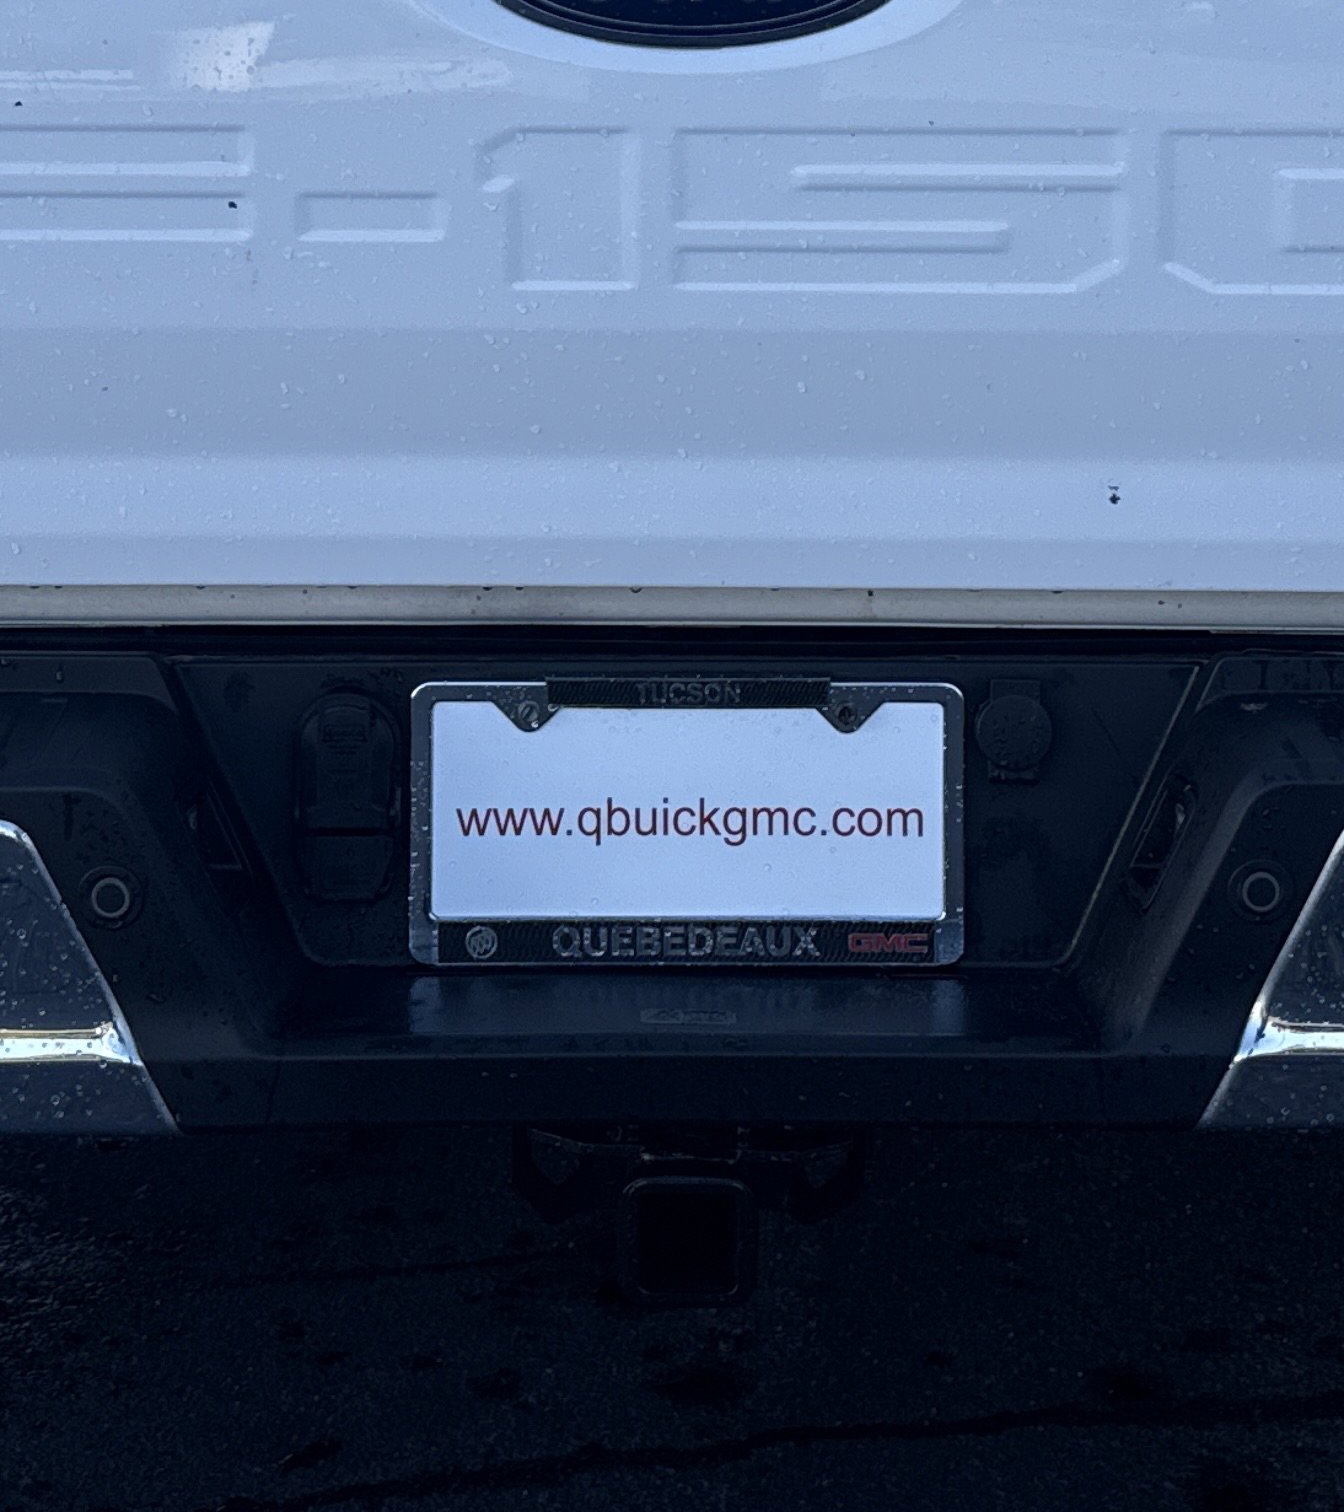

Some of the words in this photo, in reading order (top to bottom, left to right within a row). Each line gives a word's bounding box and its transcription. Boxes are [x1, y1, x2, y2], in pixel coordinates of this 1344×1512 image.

[634, 681, 741, 705] TUCSON
[456, 797, 925, 846] www.qbuickgmc.com
[551, 924, 821, 958] QUEBEDEAUX
[846, 931, 929, 955] GMC
